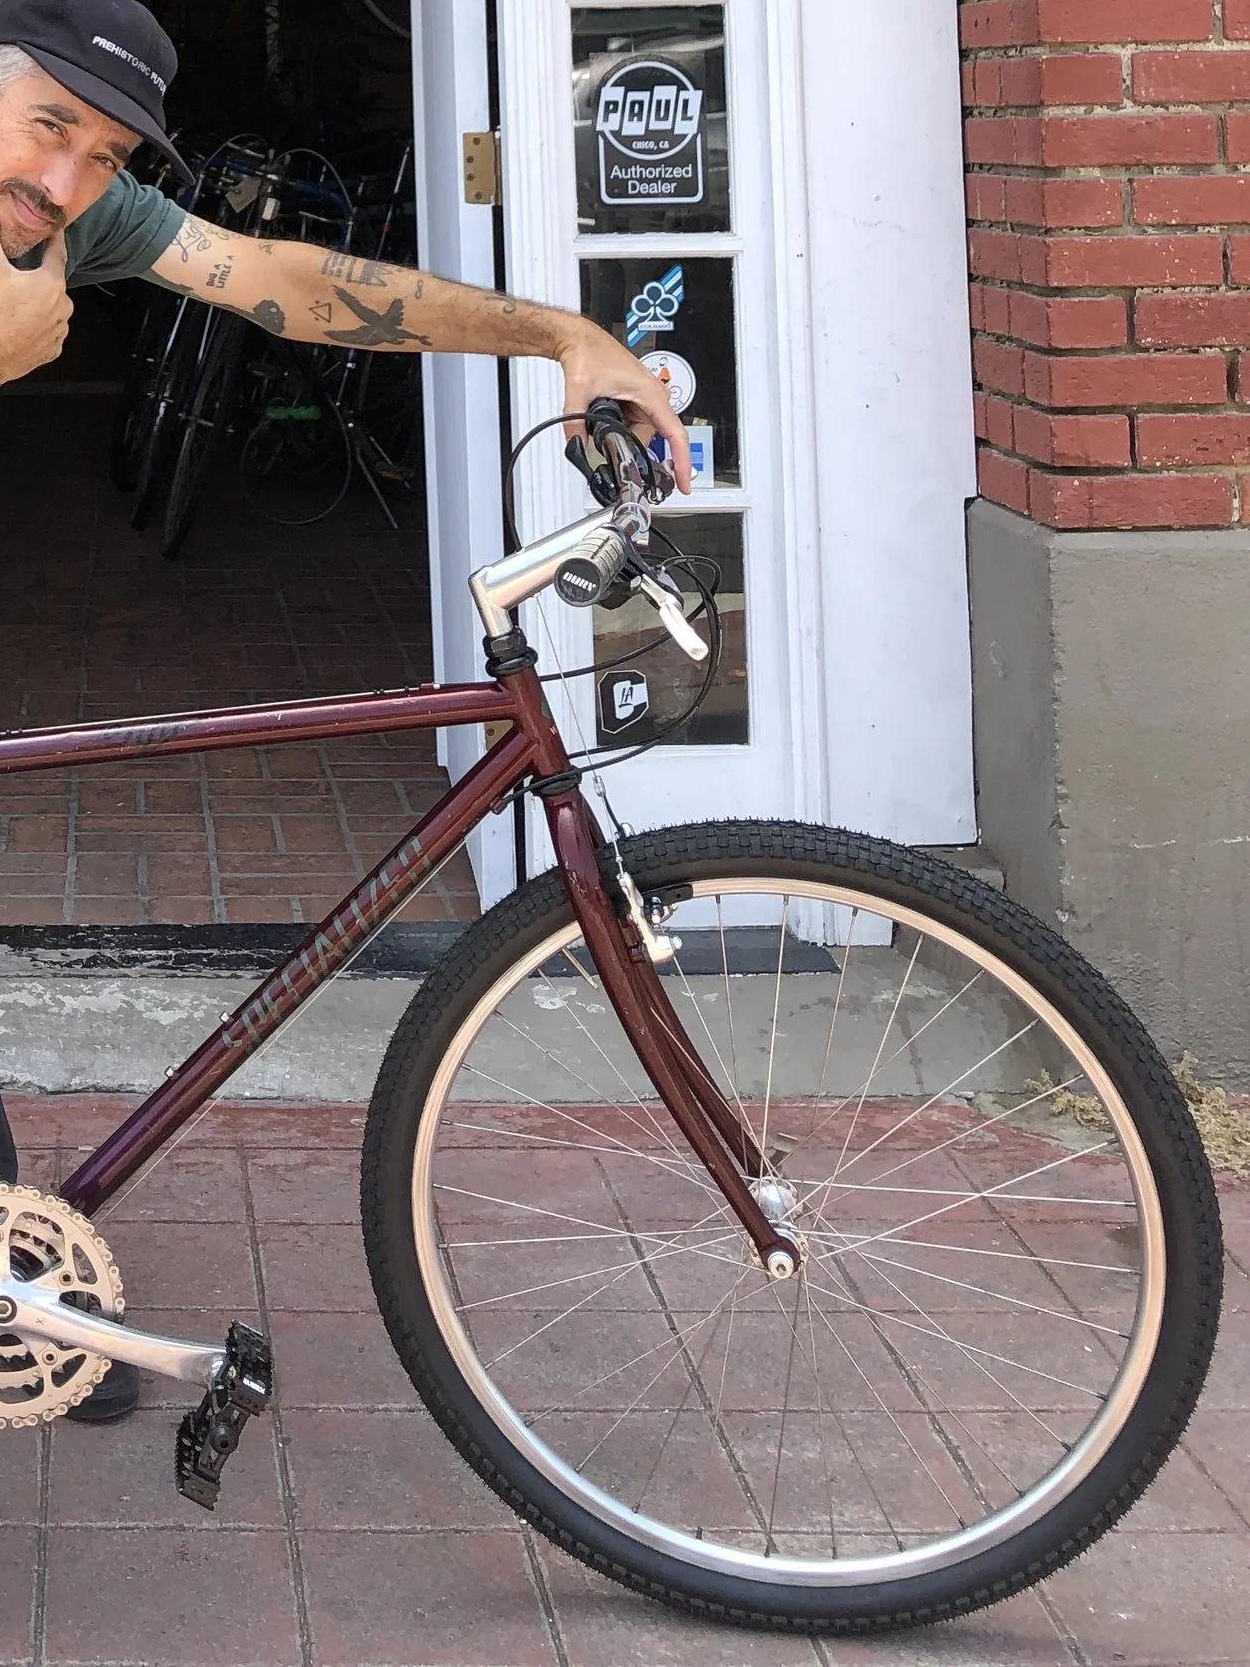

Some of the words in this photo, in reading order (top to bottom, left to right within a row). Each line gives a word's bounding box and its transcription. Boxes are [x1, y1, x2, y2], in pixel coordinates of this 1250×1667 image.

[92, 35, 151, 77] PREHISTORIC
[600, 95, 699, 127] PAUL
[631, 140, 657, 151] CHICO,
[658, 140, 670, 150] CA
[609, 164, 693, 180] Authorized
[627, 179, 677, 195] Dealer
[562, 571, 596, 592] OURY
